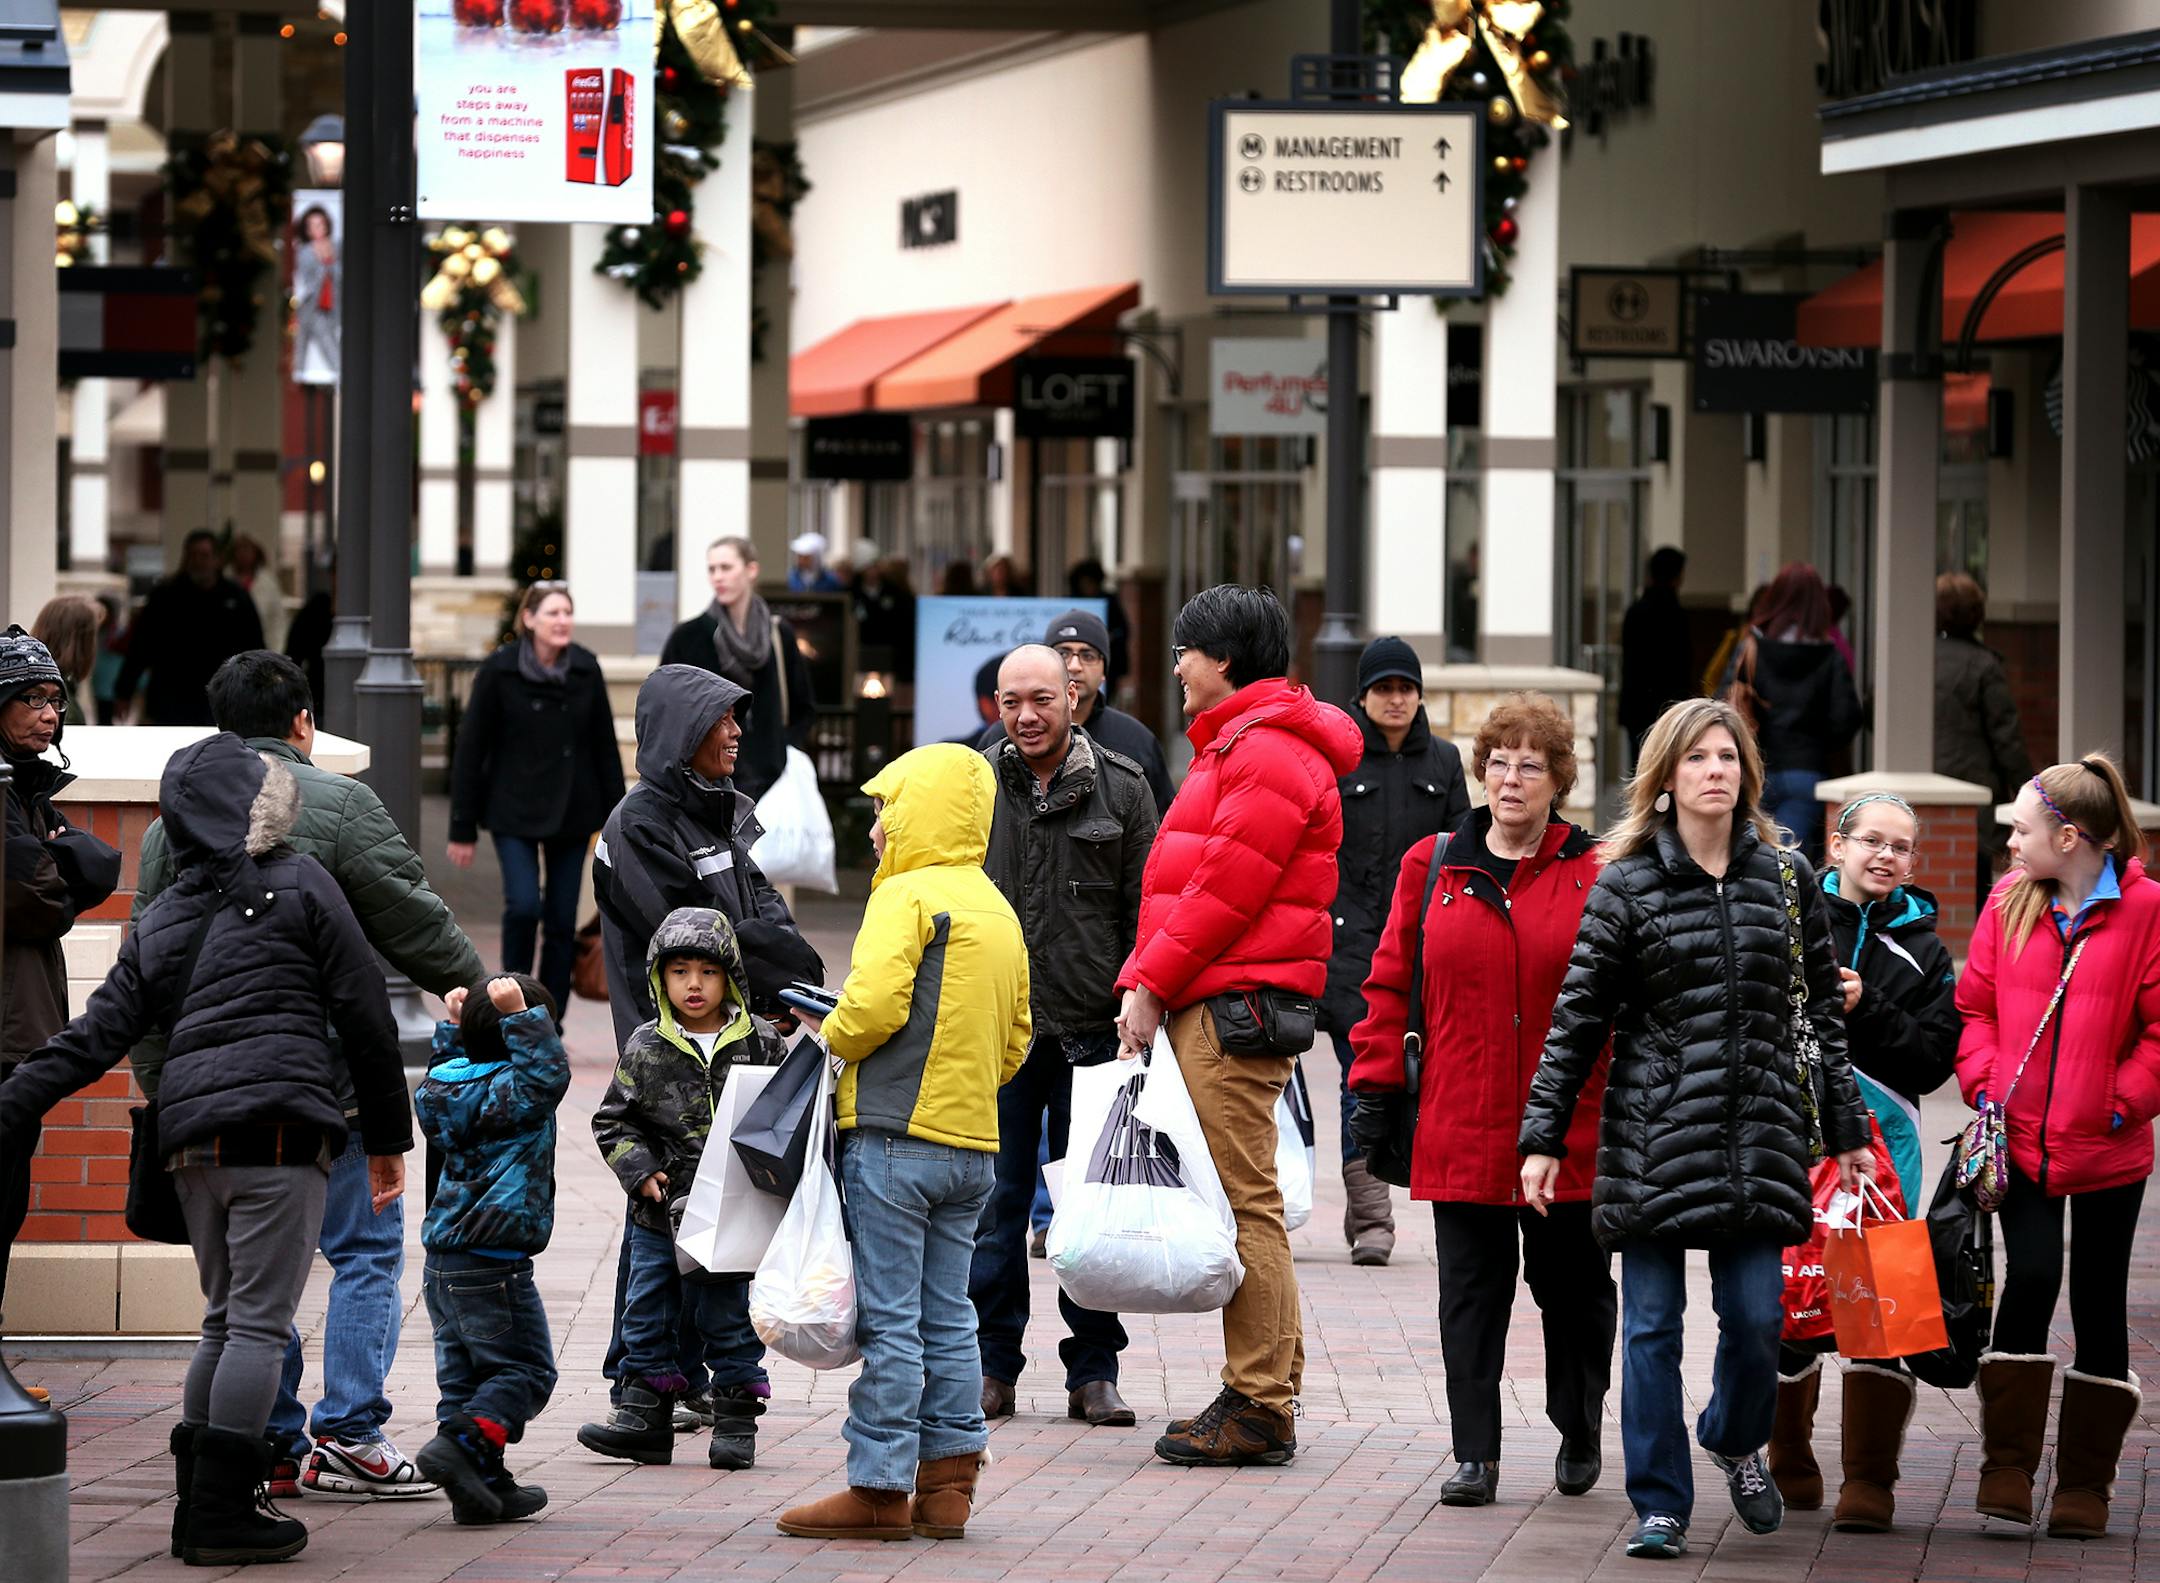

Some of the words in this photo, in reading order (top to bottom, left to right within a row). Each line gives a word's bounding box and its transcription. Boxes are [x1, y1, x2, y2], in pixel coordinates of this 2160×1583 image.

[468, 85, 491, 96] you
[496, 85, 517, 95] are
[456, 100, 491, 112] steps
[495, 101, 529, 113] away
[441, 114, 472, 126] from
[476, 117, 484, 126] a
[488, 114, 544, 127] machine
[444, 131, 471, 141] that
[475, 131, 541, 144] dispenses
[458, 148, 526, 160] happiness
[1274, 136, 1402, 159] MANAGEMENT
[1274, 170, 1384, 193] RESTROOMS
[1704, 338, 1865, 369] SWAROVSKI
[1021, 373, 1126, 409] LOFT
